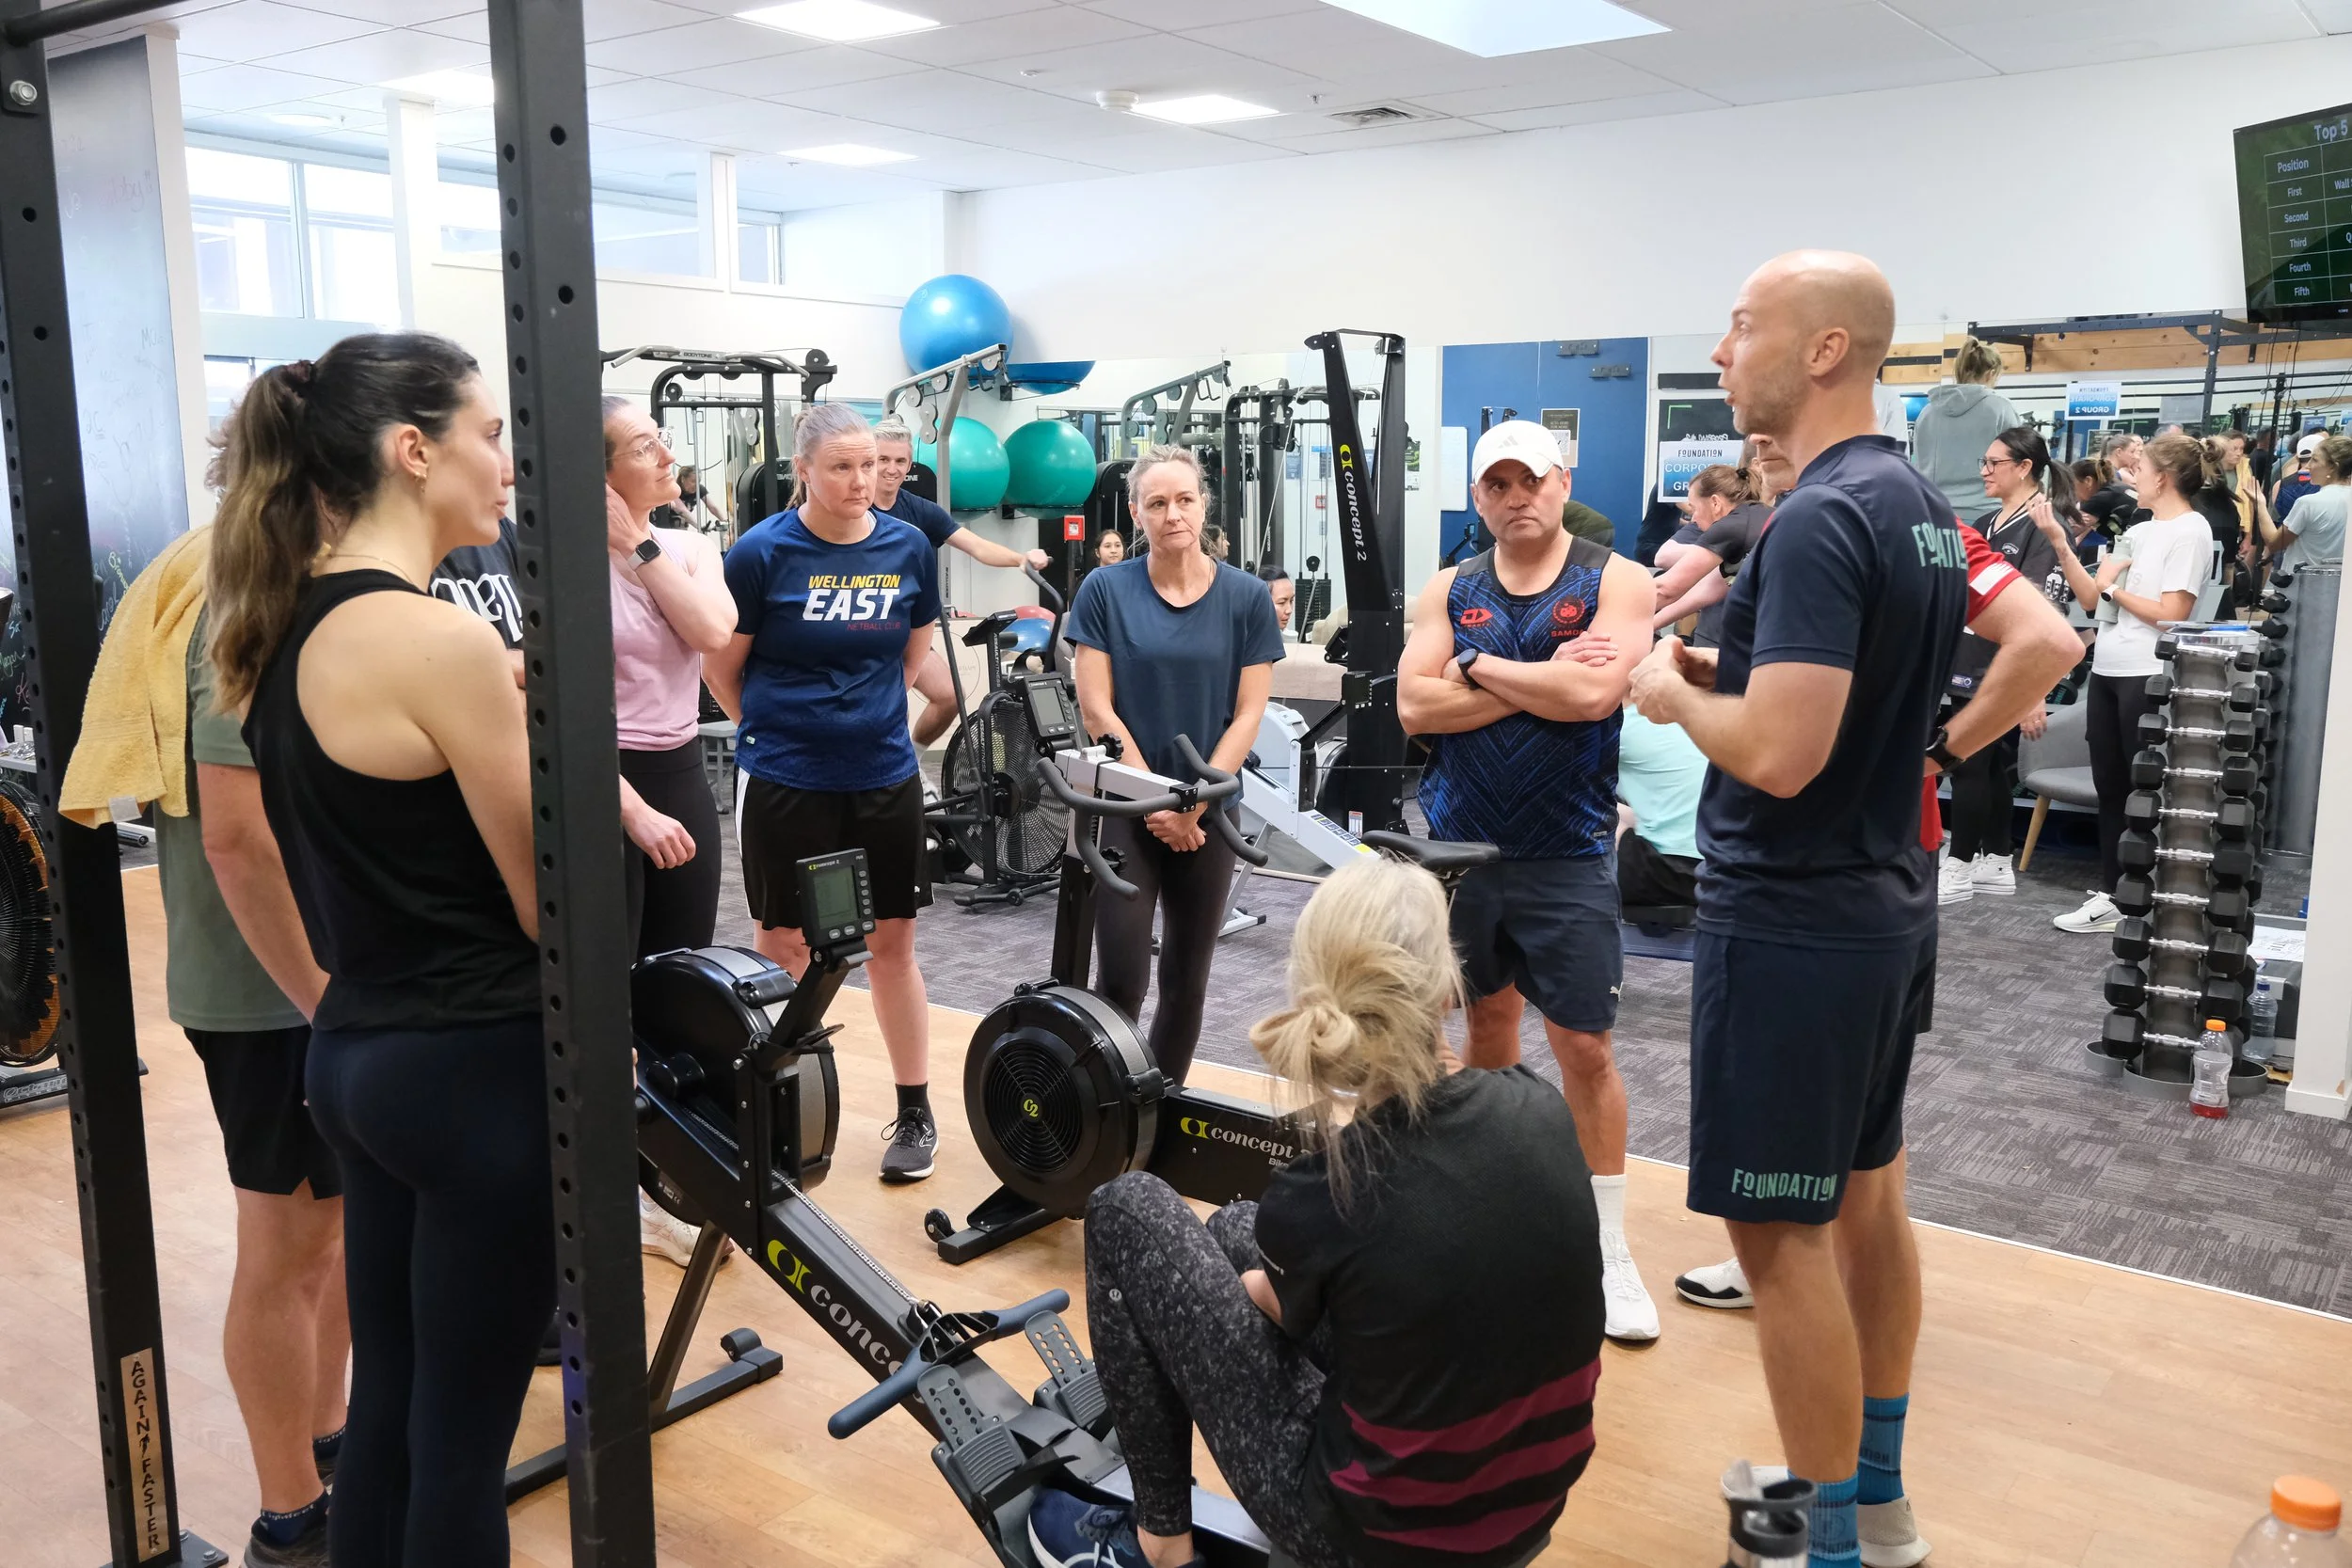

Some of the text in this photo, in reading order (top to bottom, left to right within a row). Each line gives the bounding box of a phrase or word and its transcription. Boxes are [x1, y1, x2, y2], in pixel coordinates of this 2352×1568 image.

[2314, 119, 2349, 142] Top 5
[2277, 158, 2310, 173] Position
[2334, 178, 2350, 189] Wall
[2287, 187, 2302, 197] First
[2283, 211, 2309, 223] Second
[2289, 236, 2307, 248] Third
[2289, 261, 2311, 273] Fourth
[2294, 286, 2310, 296] Fifth
[1677, 449, 1723, 458] FOUNDATION
[1343, 471, 1368, 562] concept 2
[808, 575, 901, 589] WELLINGTON
[803, 588, 900, 621] EAST
[847, 622, 882, 631] NETBALL
[1210, 1127, 1295, 1159] concept
[1731, 1168, 1838, 1201] FOUNDATION
[131, 1360, 161, 1549] AGAIN FASTER
